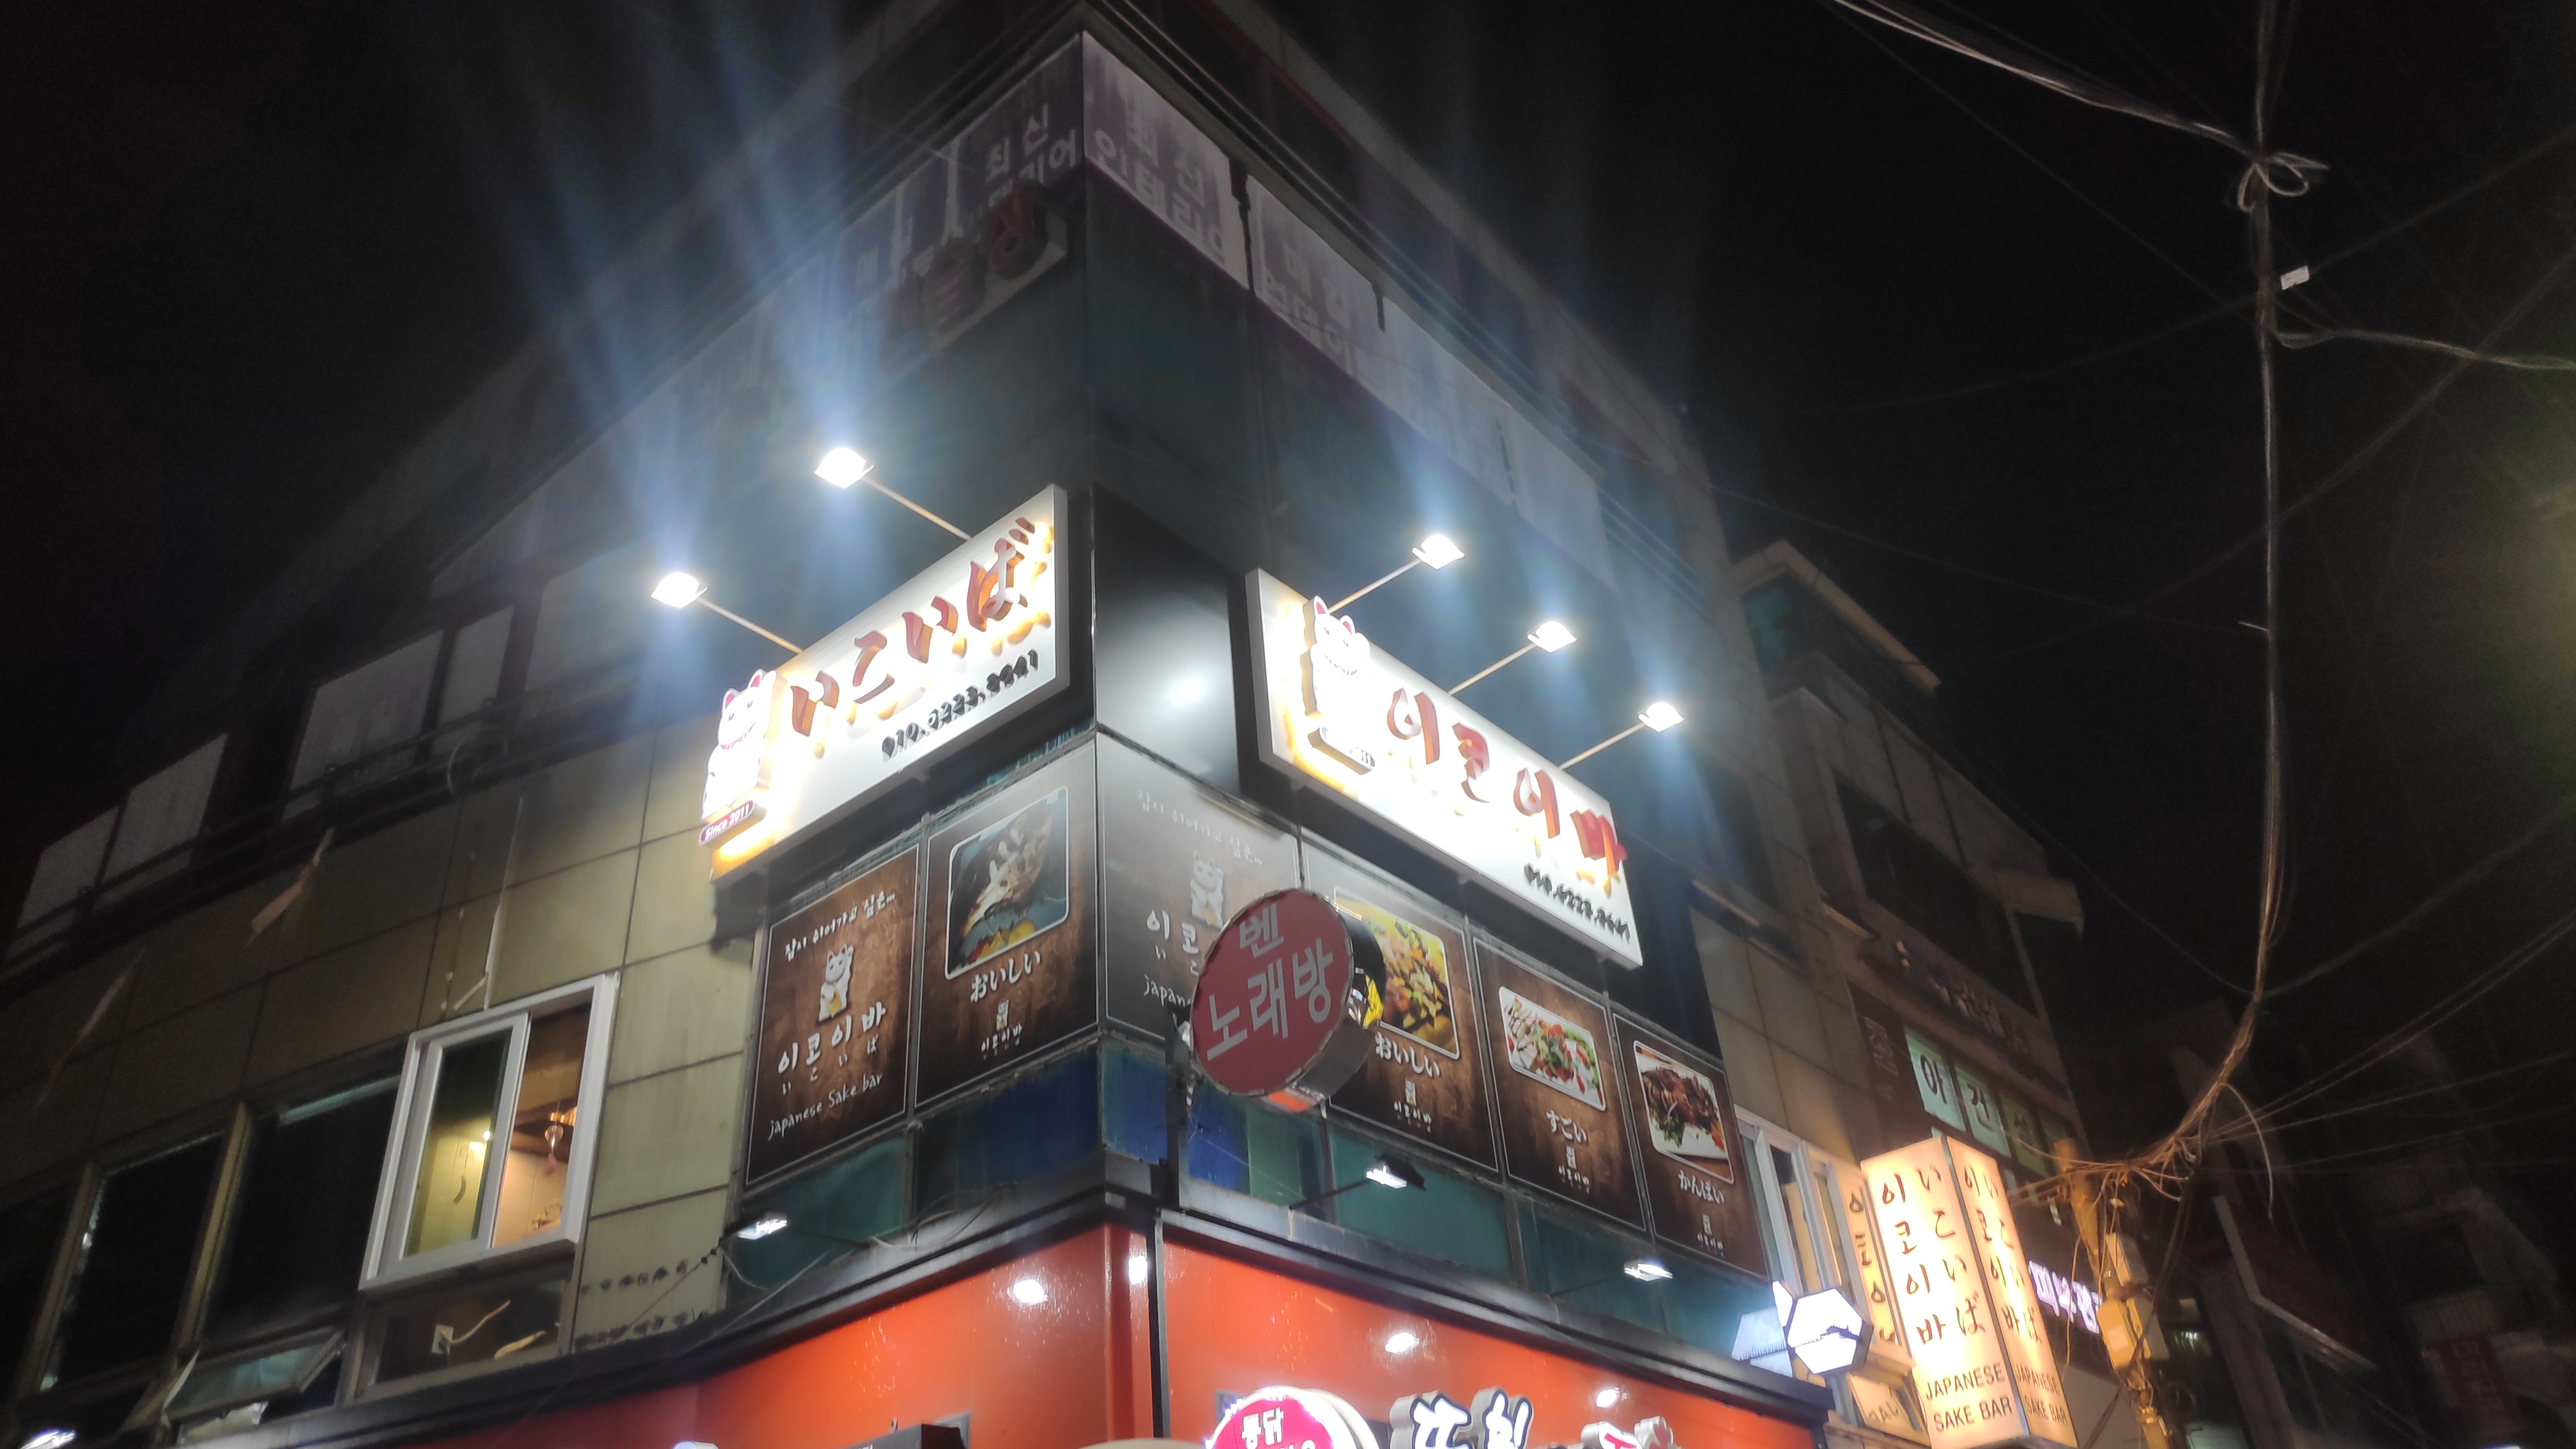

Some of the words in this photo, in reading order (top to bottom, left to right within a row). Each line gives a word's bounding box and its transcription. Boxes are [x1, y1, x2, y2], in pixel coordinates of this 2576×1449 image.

[791, 516, 1035, 737] いこいば
[1138, 789, 1164, 812] 잠시
[1386, 688, 1627, 874] 이코이바
[730, 802, 749, 825] 2011
[785, 937, 807, 962] 잠시
[1238, 904, 1284, 958] 벤
[970, 951, 1041, 1003] おいしい
[1206, 939, 1333, 1061] 노래방
[778, 1001, 887, 1074] 이코이바
[1375, 1031, 1441, 1078] おいしい
[829, 1084, 857, 1108] Sake
[862, 1073, 884, 1092] bar
[1546, 1109, 1587, 1144] すごい
[1882, 1173, 1947, 1345] 이코이바
[1917, 1165, 1986, 1337] いこいば
[1964, 1165, 2020, 1335] 이코이바
[1925, 1363, 2006, 1401] JAPANESE
[2016, 1363, 2060, 1395] JAPANESE
[1933, 1405, 1975, 1432] SAKE
[1981, 1397, 2014, 1422] BAR
[2023, 1394, 2047, 1418] SAKE
[2050, 1403, 2067, 1425] BAR
